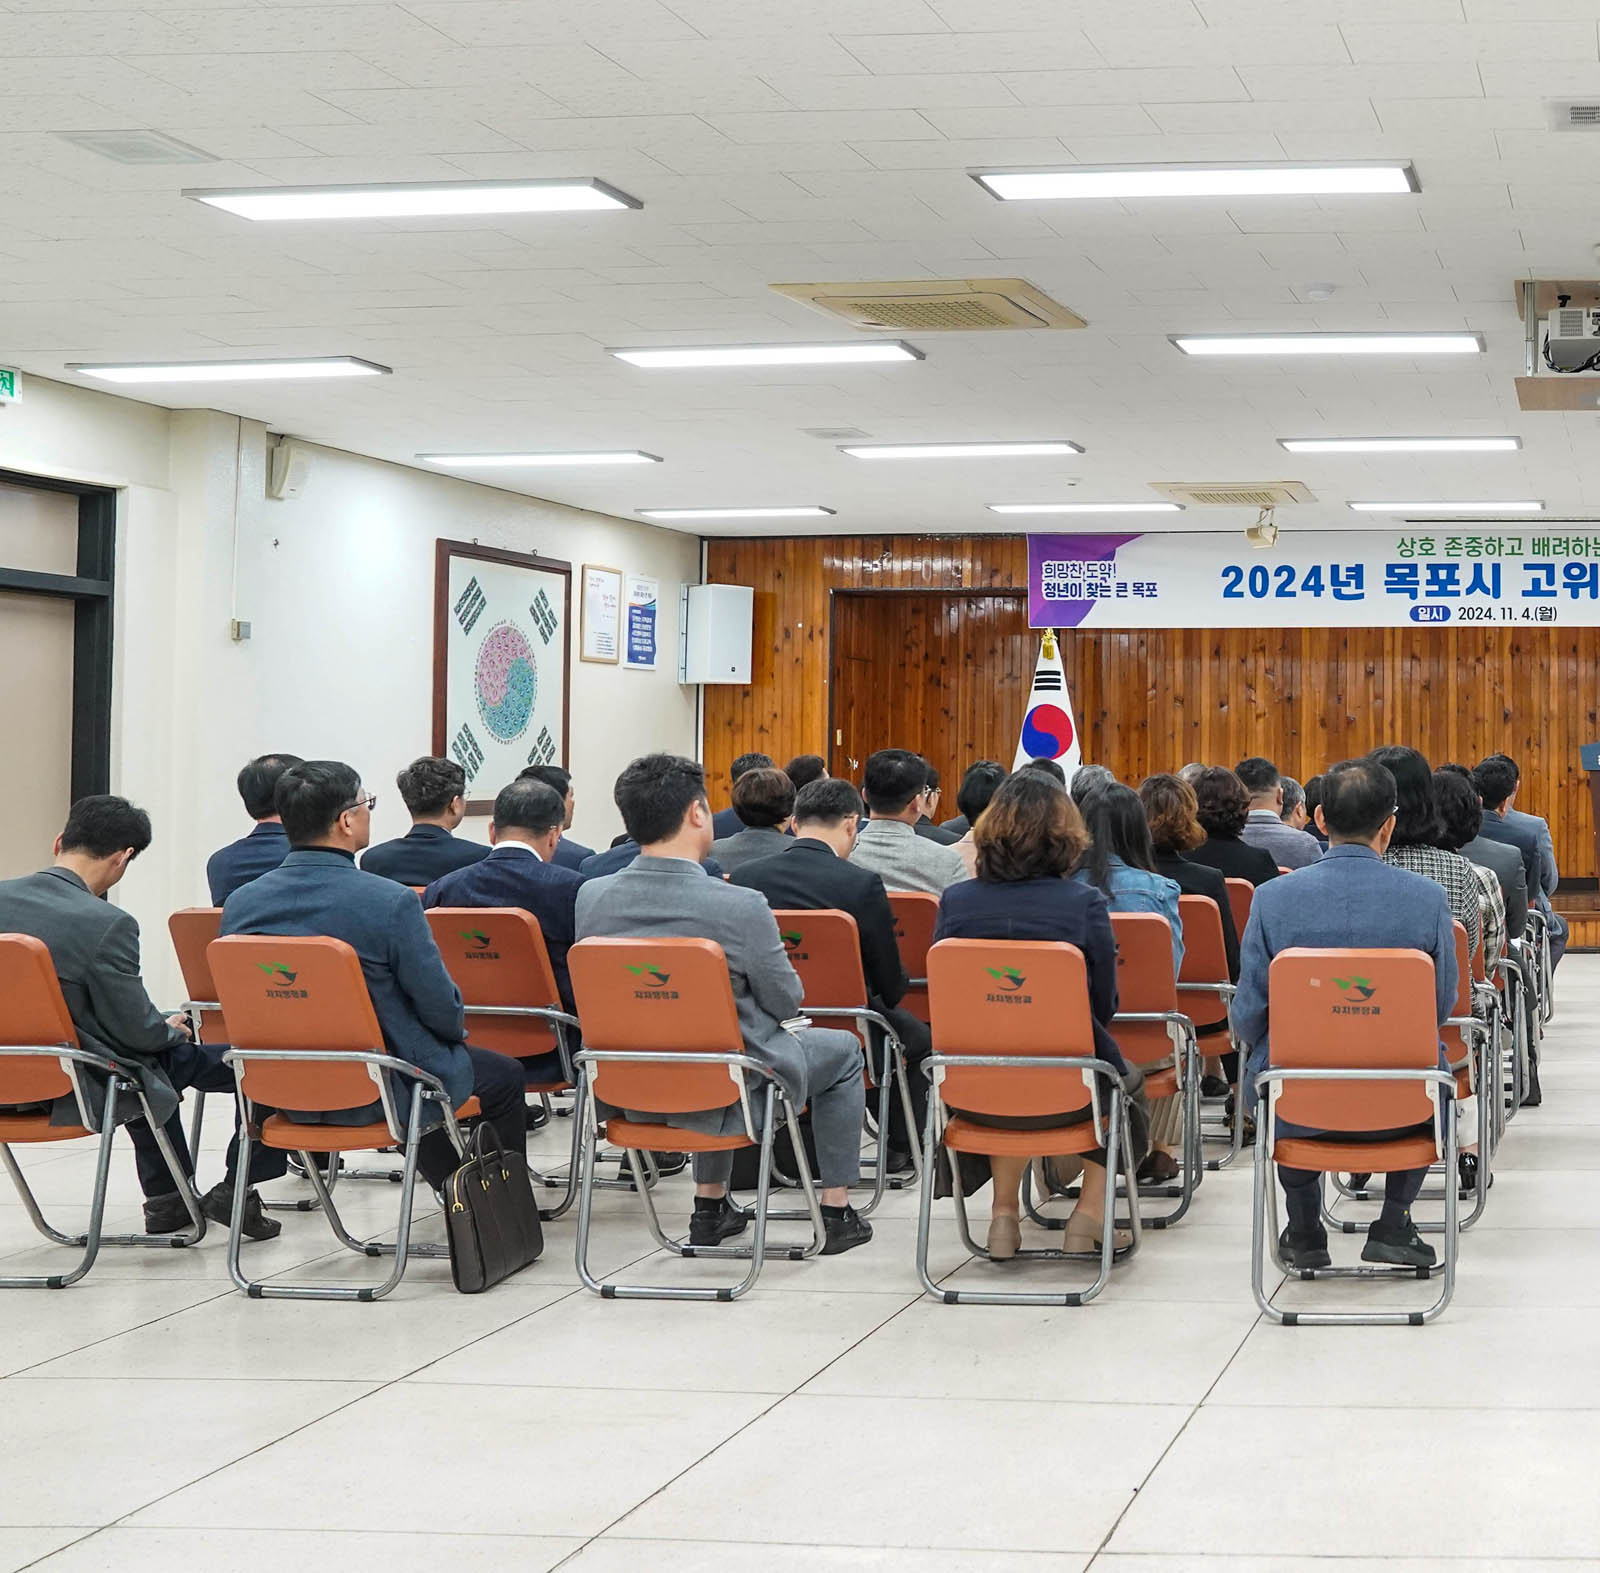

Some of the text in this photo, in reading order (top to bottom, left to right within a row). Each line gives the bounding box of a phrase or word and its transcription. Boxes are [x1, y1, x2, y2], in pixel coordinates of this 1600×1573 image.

[1396, 536, 1436, 558] 상호
[1444, 537, 1525, 558] 존중하고
[1044, 562, 1117, 580] 희망찬 도약!
[1044, 582, 1158, 598] 청년이 찾는 큰 목포
[1221, 562, 1366, 601] 2024년
[1384, 562, 1502, 601] 목포시
[1417, 607, 1444, 621] 일시
[1458, 606, 1497, 621] 2024.
[1500, 606, 1518, 621] 11.
